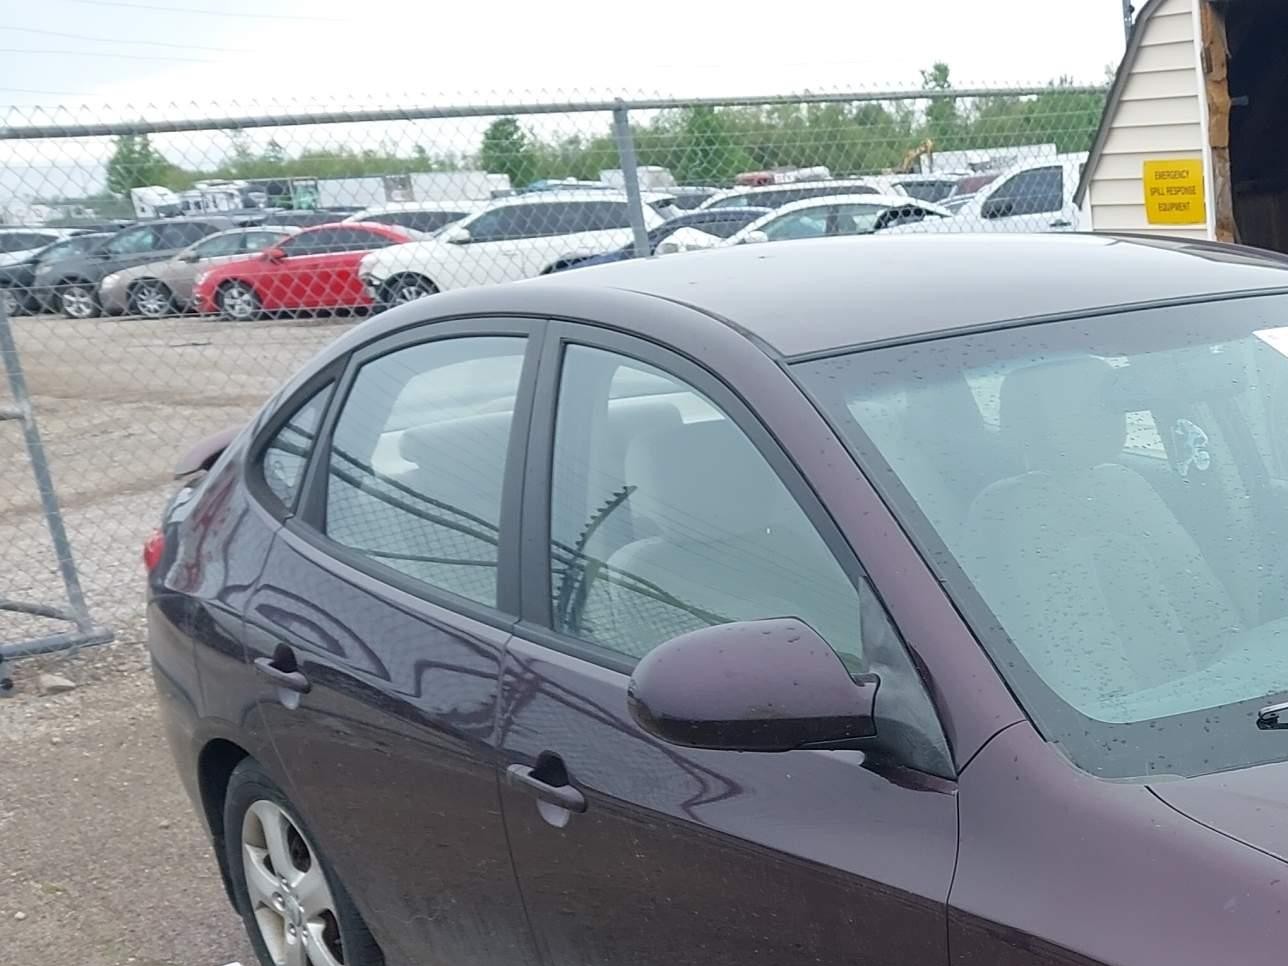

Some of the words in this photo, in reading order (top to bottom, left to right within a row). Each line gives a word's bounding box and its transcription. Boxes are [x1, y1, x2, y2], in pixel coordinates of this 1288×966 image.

[1154, 170, 1189, 180] EMERGENCY
[1150, 187, 1165, 196] SPILL
[1166, 185, 1196, 195] RESPONSE
[1158, 201, 1190, 212] EQUIPMENT
